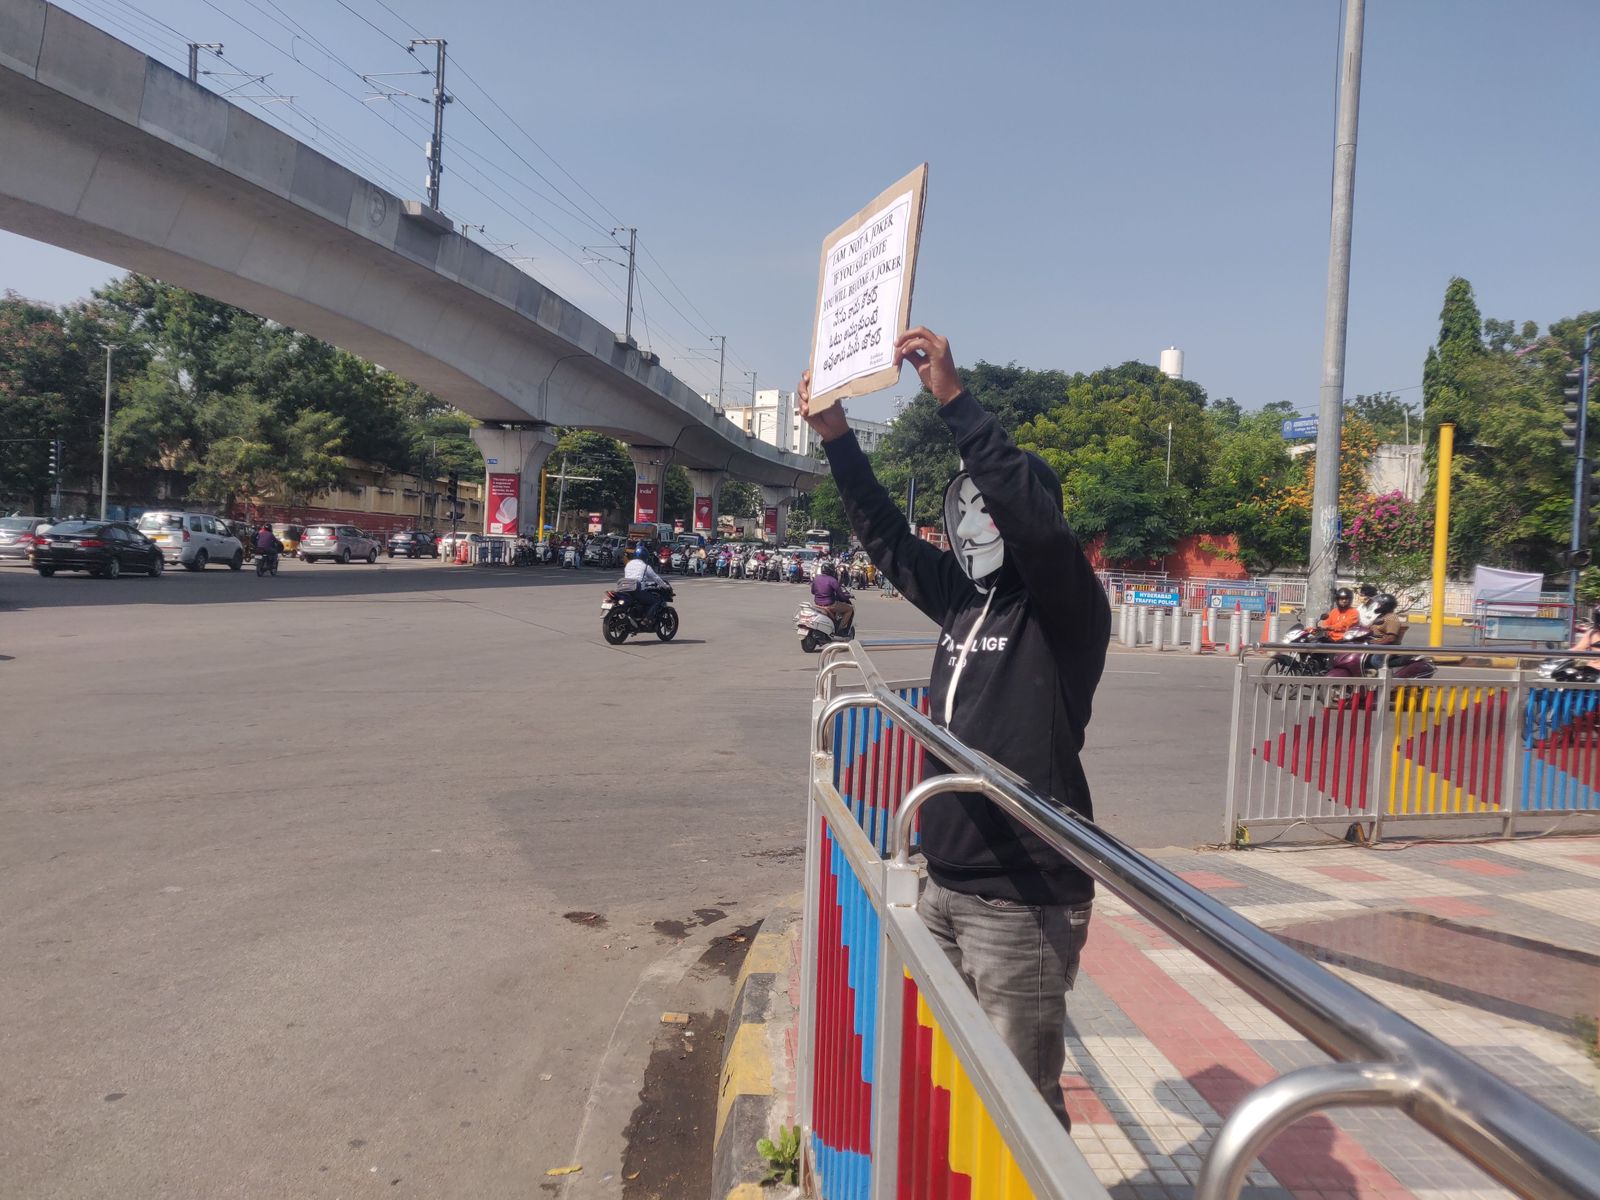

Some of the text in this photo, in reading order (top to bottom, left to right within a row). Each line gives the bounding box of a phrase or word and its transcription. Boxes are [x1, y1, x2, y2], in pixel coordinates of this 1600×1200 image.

[833, 270, 839, 286] IF
[839, 263, 855, 282] YOU
[868, 239, 888, 261] VOTE
[836, 247, 846, 264] AM
[849, 236, 864, 257] NOT
[864, 232, 869, 244] A
[869, 213, 894, 245] JOKER
[834, 287, 847, 305] WILL
[848, 271, 869, 297] BECOME
[875, 255, 902, 281] JOKER
[1139, 592, 1172, 600] HYDERABAD
